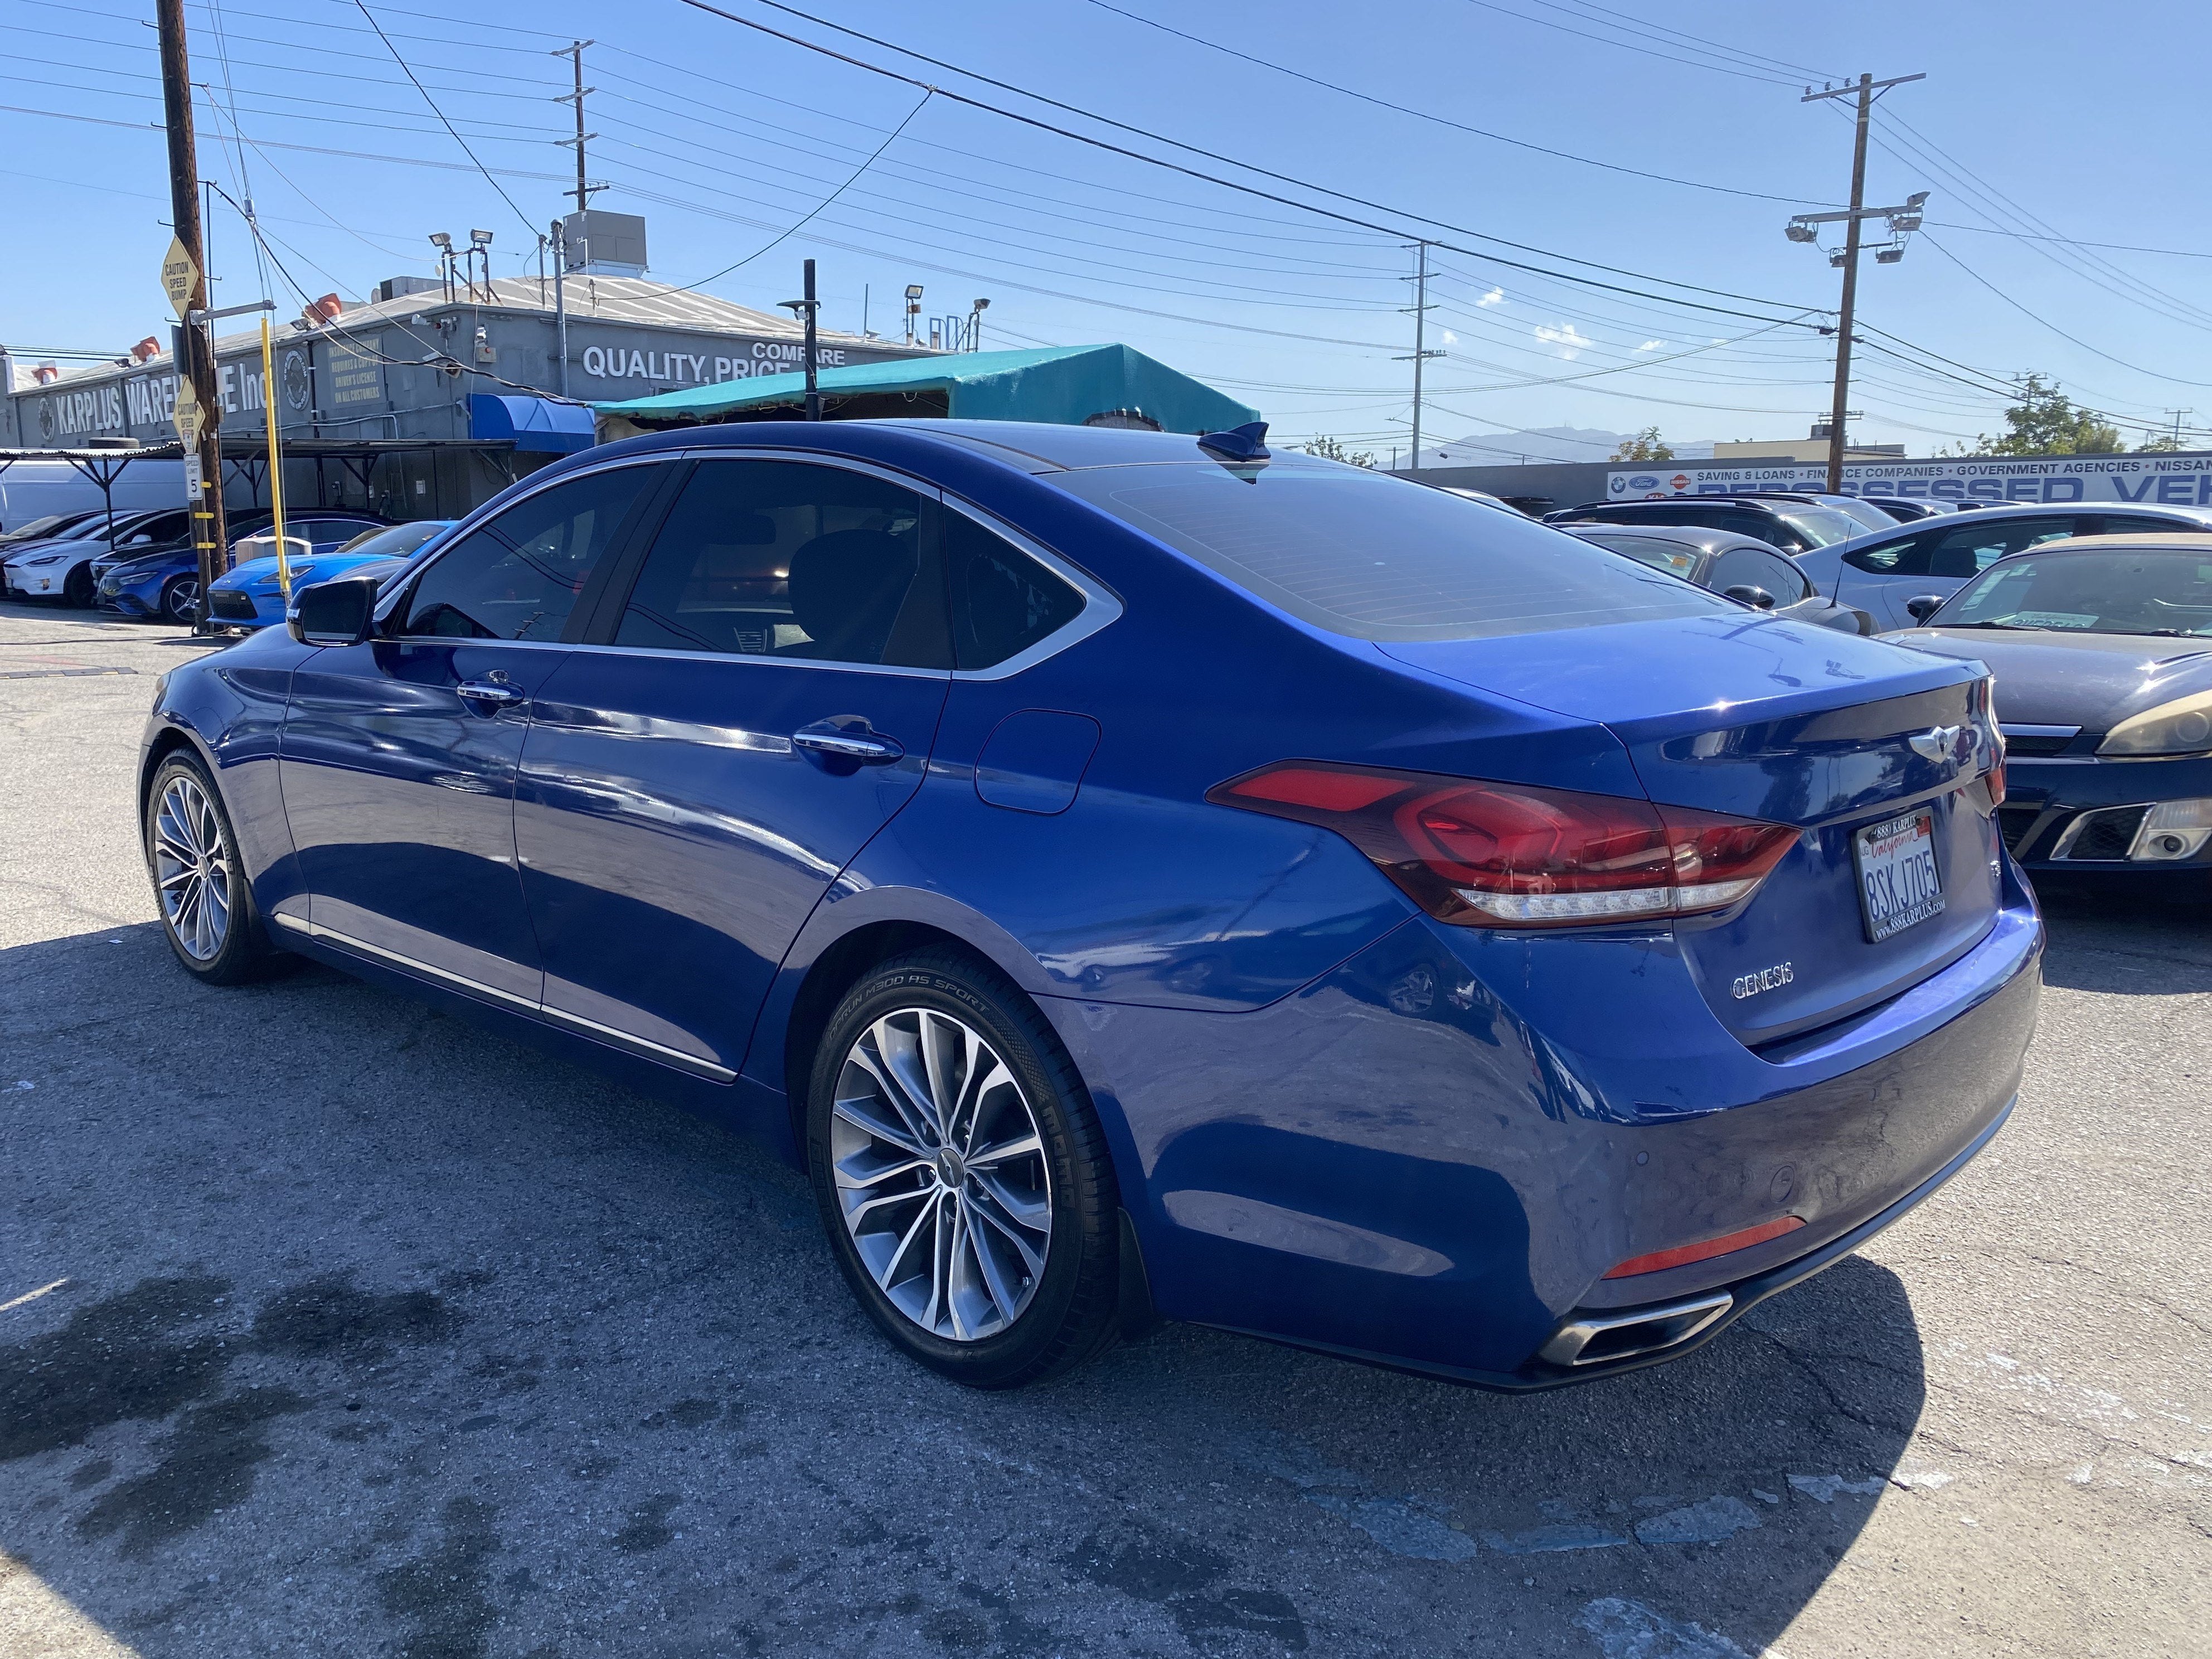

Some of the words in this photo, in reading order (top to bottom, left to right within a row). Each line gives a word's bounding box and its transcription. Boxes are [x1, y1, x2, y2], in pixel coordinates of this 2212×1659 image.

[165, 261, 189, 276] CAUTION
[169, 277, 187, 289] SPEED
[171, 289, 187, 301] BUMP
[752, 342, 845, 366] COMPRE
[331, 359, 353, 373] REQUIRES
[335, 374, 356, 387] DRIVER'S
[356, 371, 377, 385] LICENSE
[334, 391, 342, 403] ON
[342, 390, 351, 401] ALL
[351, 386, 380, 401] CUSTOMERS
[56, 386, 122, 434] KARPLUS
[178, 403, 197, 416] CAUTION
[181, 418, 193, 428] SPEED
[1697, 471, 1740, 481] SAVING
[1745, 470, 1752, 479] &
[1755, 470, 1795, 479] LOANS
[1807, 468, 1862, 479] FINCE
[1865, 467, 1943, 477] COMPANIES
[1957, 464, 2059, 475] GOVERNMENT
[2063, 462, 2141, 473] AGENCIES
[191, 479, 197, 492] 5
[1893, 814, 1917, 834] KARPLUS
[1871, 830, 1919, 860] California
[1866, 850, 1937, 920] 8SKJ705
[1731, 962, 1794, 999] GENESIS
[866, 976, 904, 997] M300
[909, 975, 930, 984] AS
[934, 979, 990, 1012] SPORT
